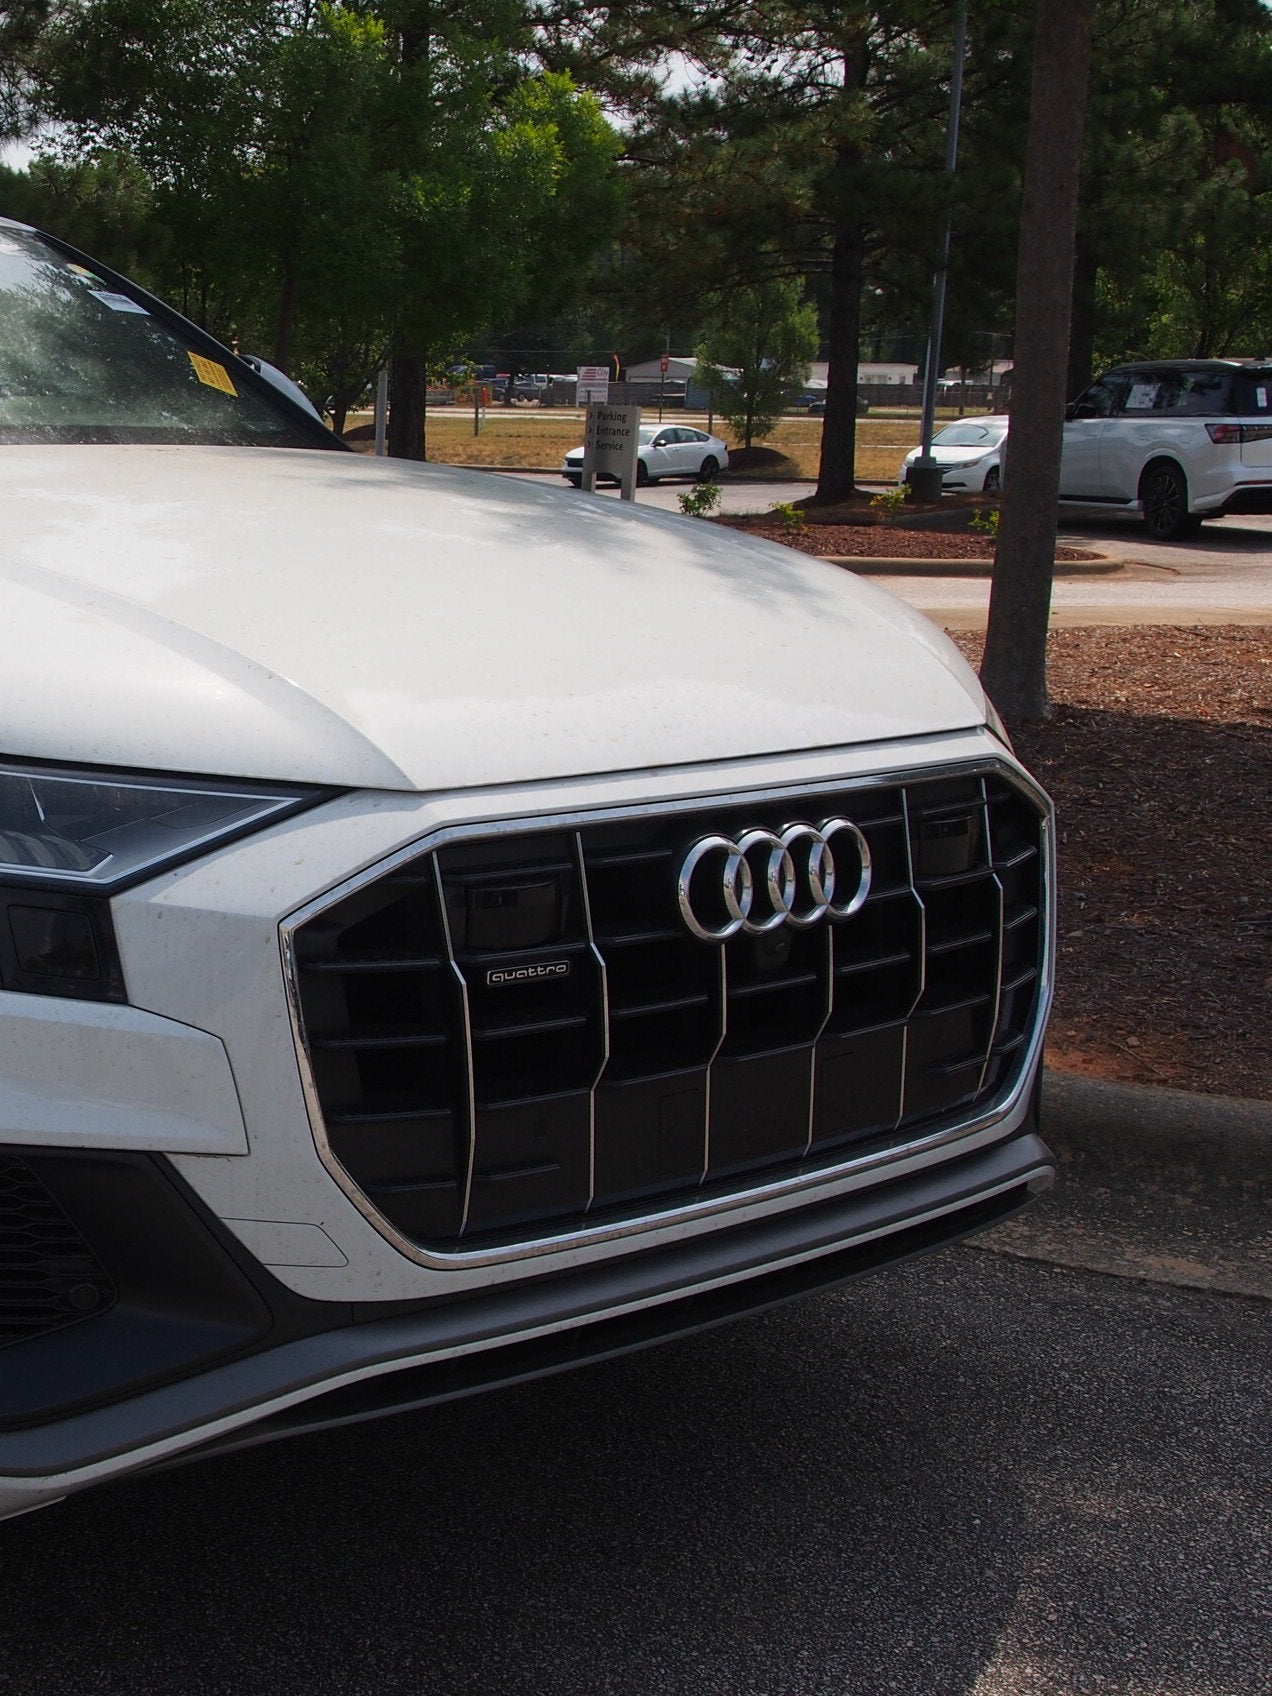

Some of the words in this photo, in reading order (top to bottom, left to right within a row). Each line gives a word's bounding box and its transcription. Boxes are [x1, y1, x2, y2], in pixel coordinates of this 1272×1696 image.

[597, 411, 627, 424] Parking
[596, 426, 630, 437] Entrance
[595, 440, 624, 451] Service
[492, 964, 567, 982] quattro
